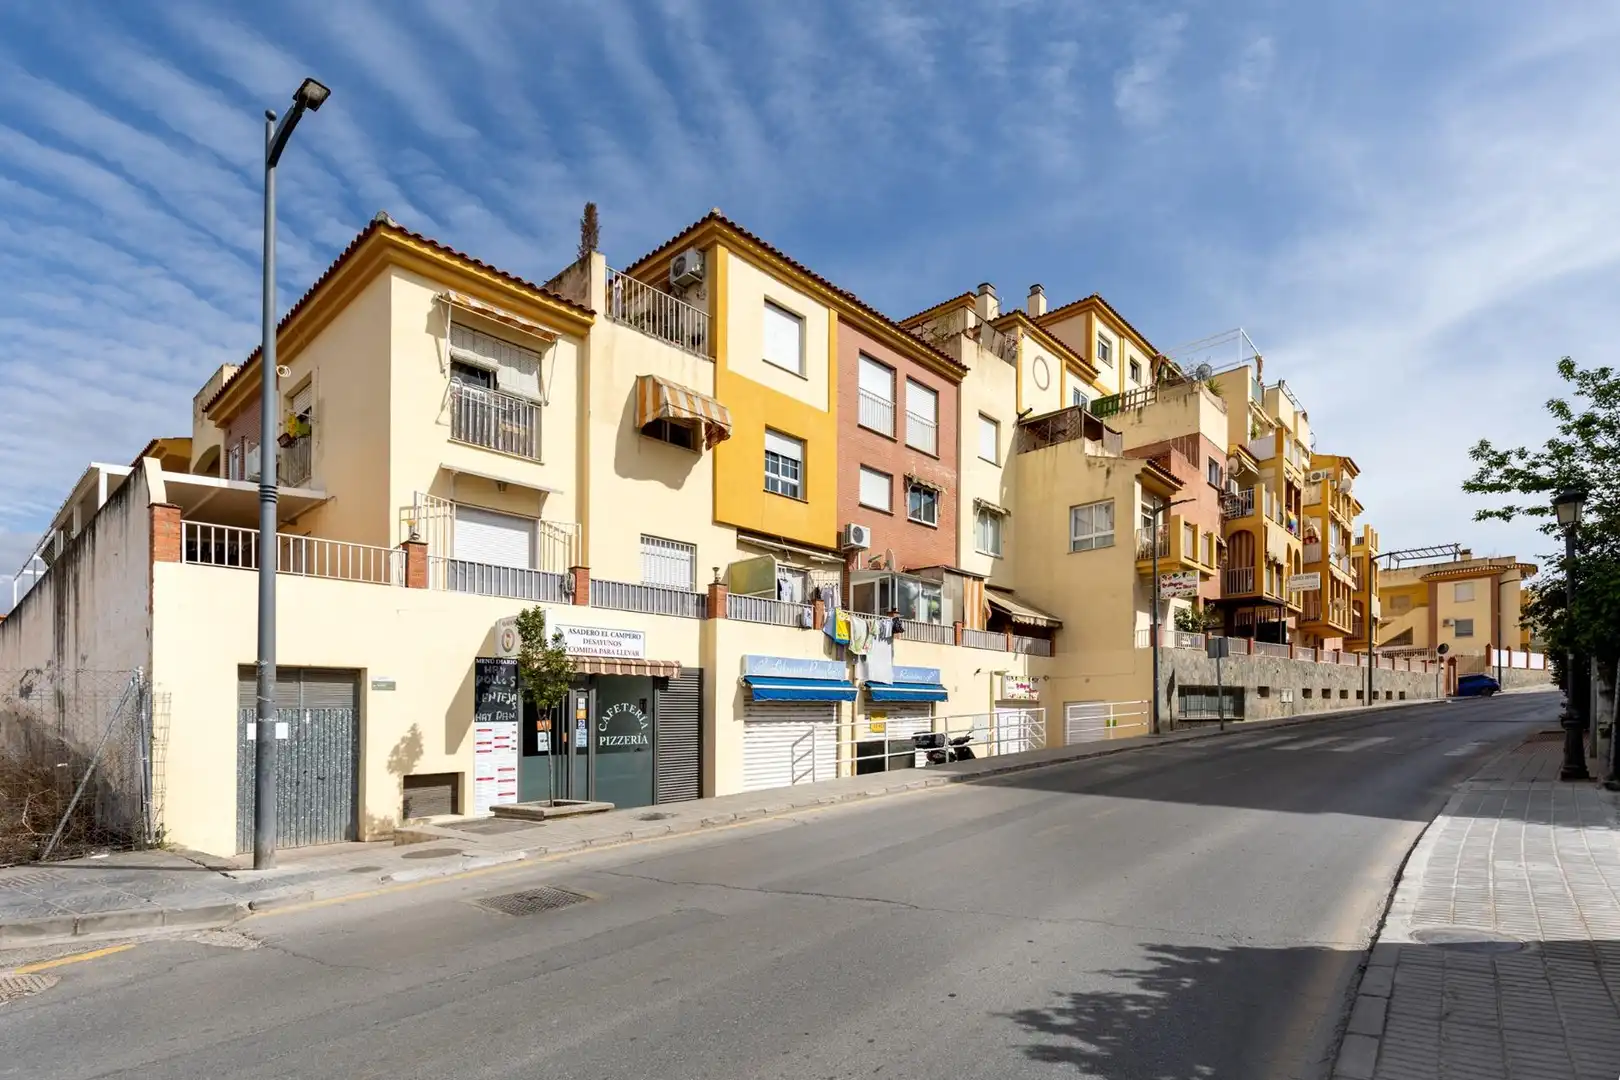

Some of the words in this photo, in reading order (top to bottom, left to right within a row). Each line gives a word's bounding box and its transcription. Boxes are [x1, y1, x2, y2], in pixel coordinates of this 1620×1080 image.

[568, 628, 600, 637] ASADERO
[610, 631, 641, 640] CAMPERO
[582, 638, 622, 647] DESAYUNOS
[568, 646, 598, 654] COMIDA
[598, 702, 648, 732] CAFETERÍA
[599, 732, 649, 746] PIZZERÍA
